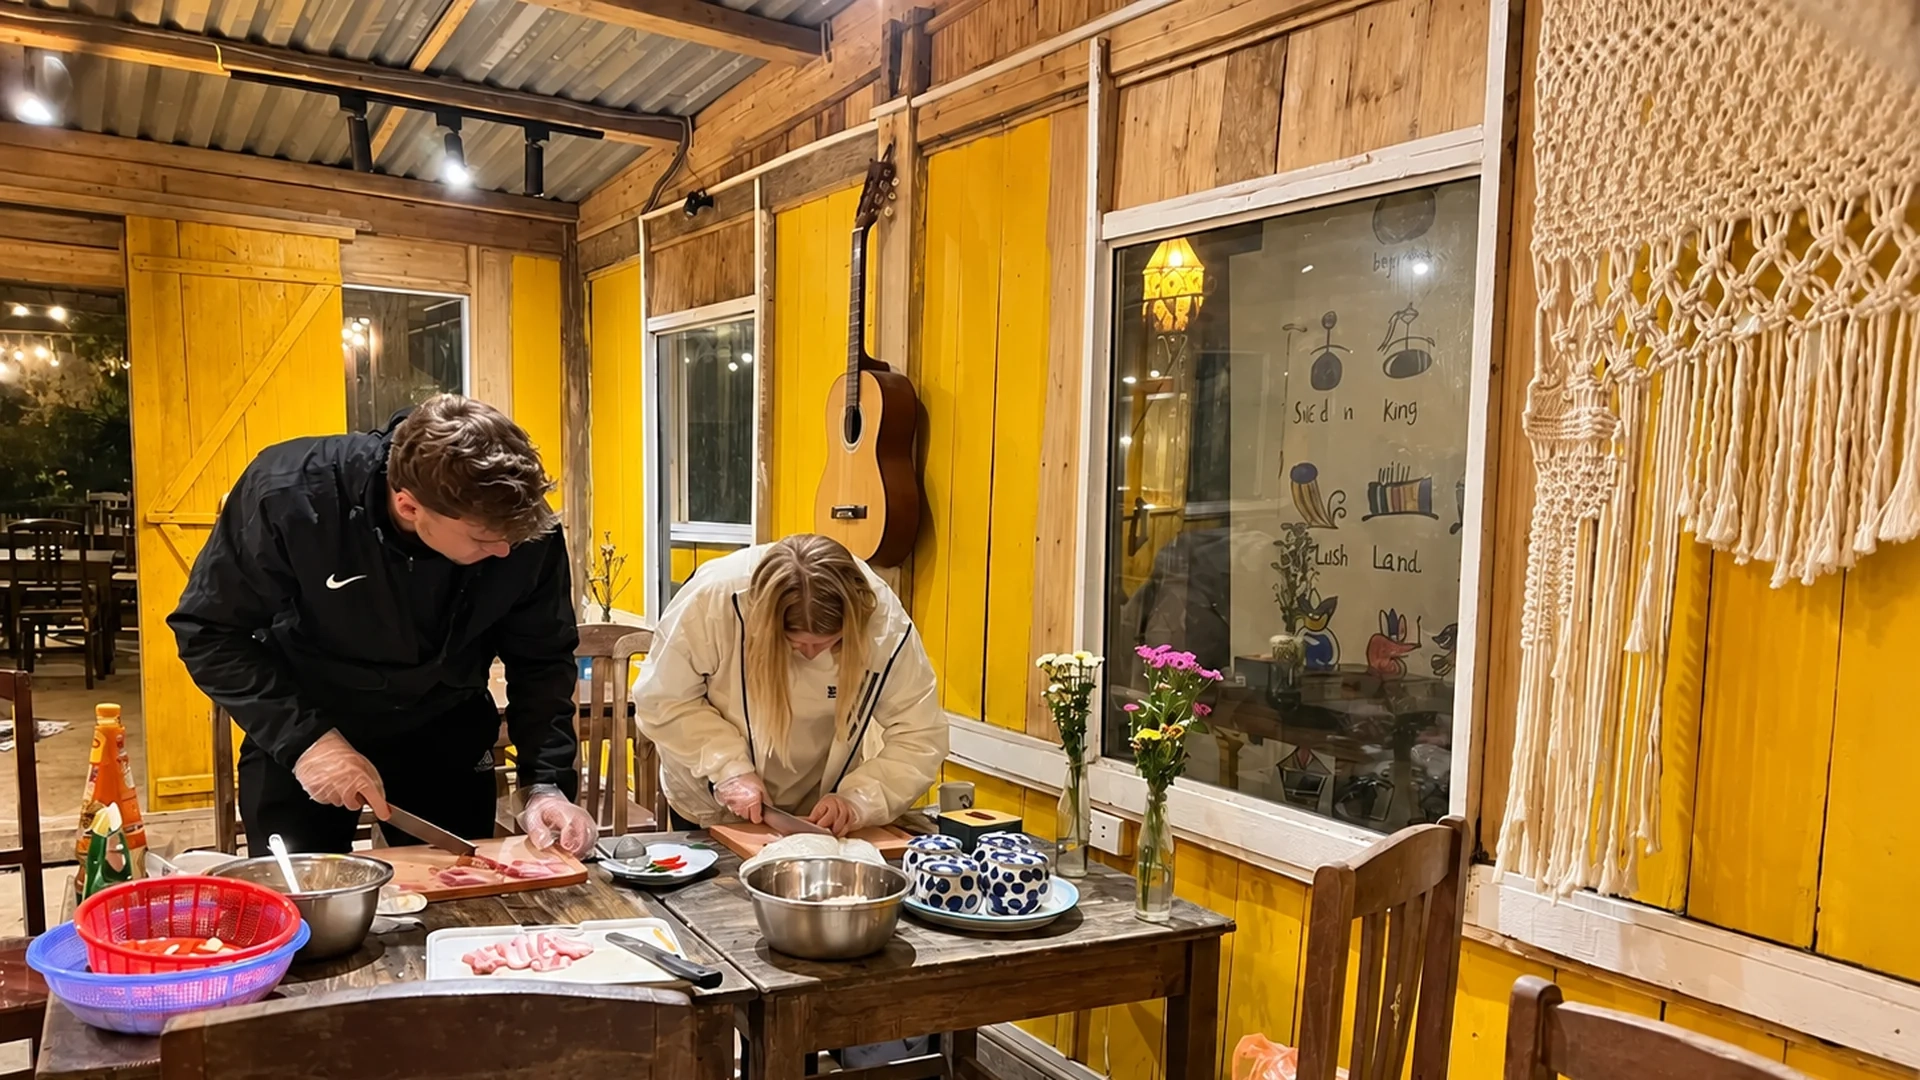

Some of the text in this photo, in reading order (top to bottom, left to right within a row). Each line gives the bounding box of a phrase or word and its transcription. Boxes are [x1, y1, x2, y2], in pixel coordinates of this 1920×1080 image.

[1383, 398, 1417, 426] King
[1315, 543, 1422, 573] Lush Land
